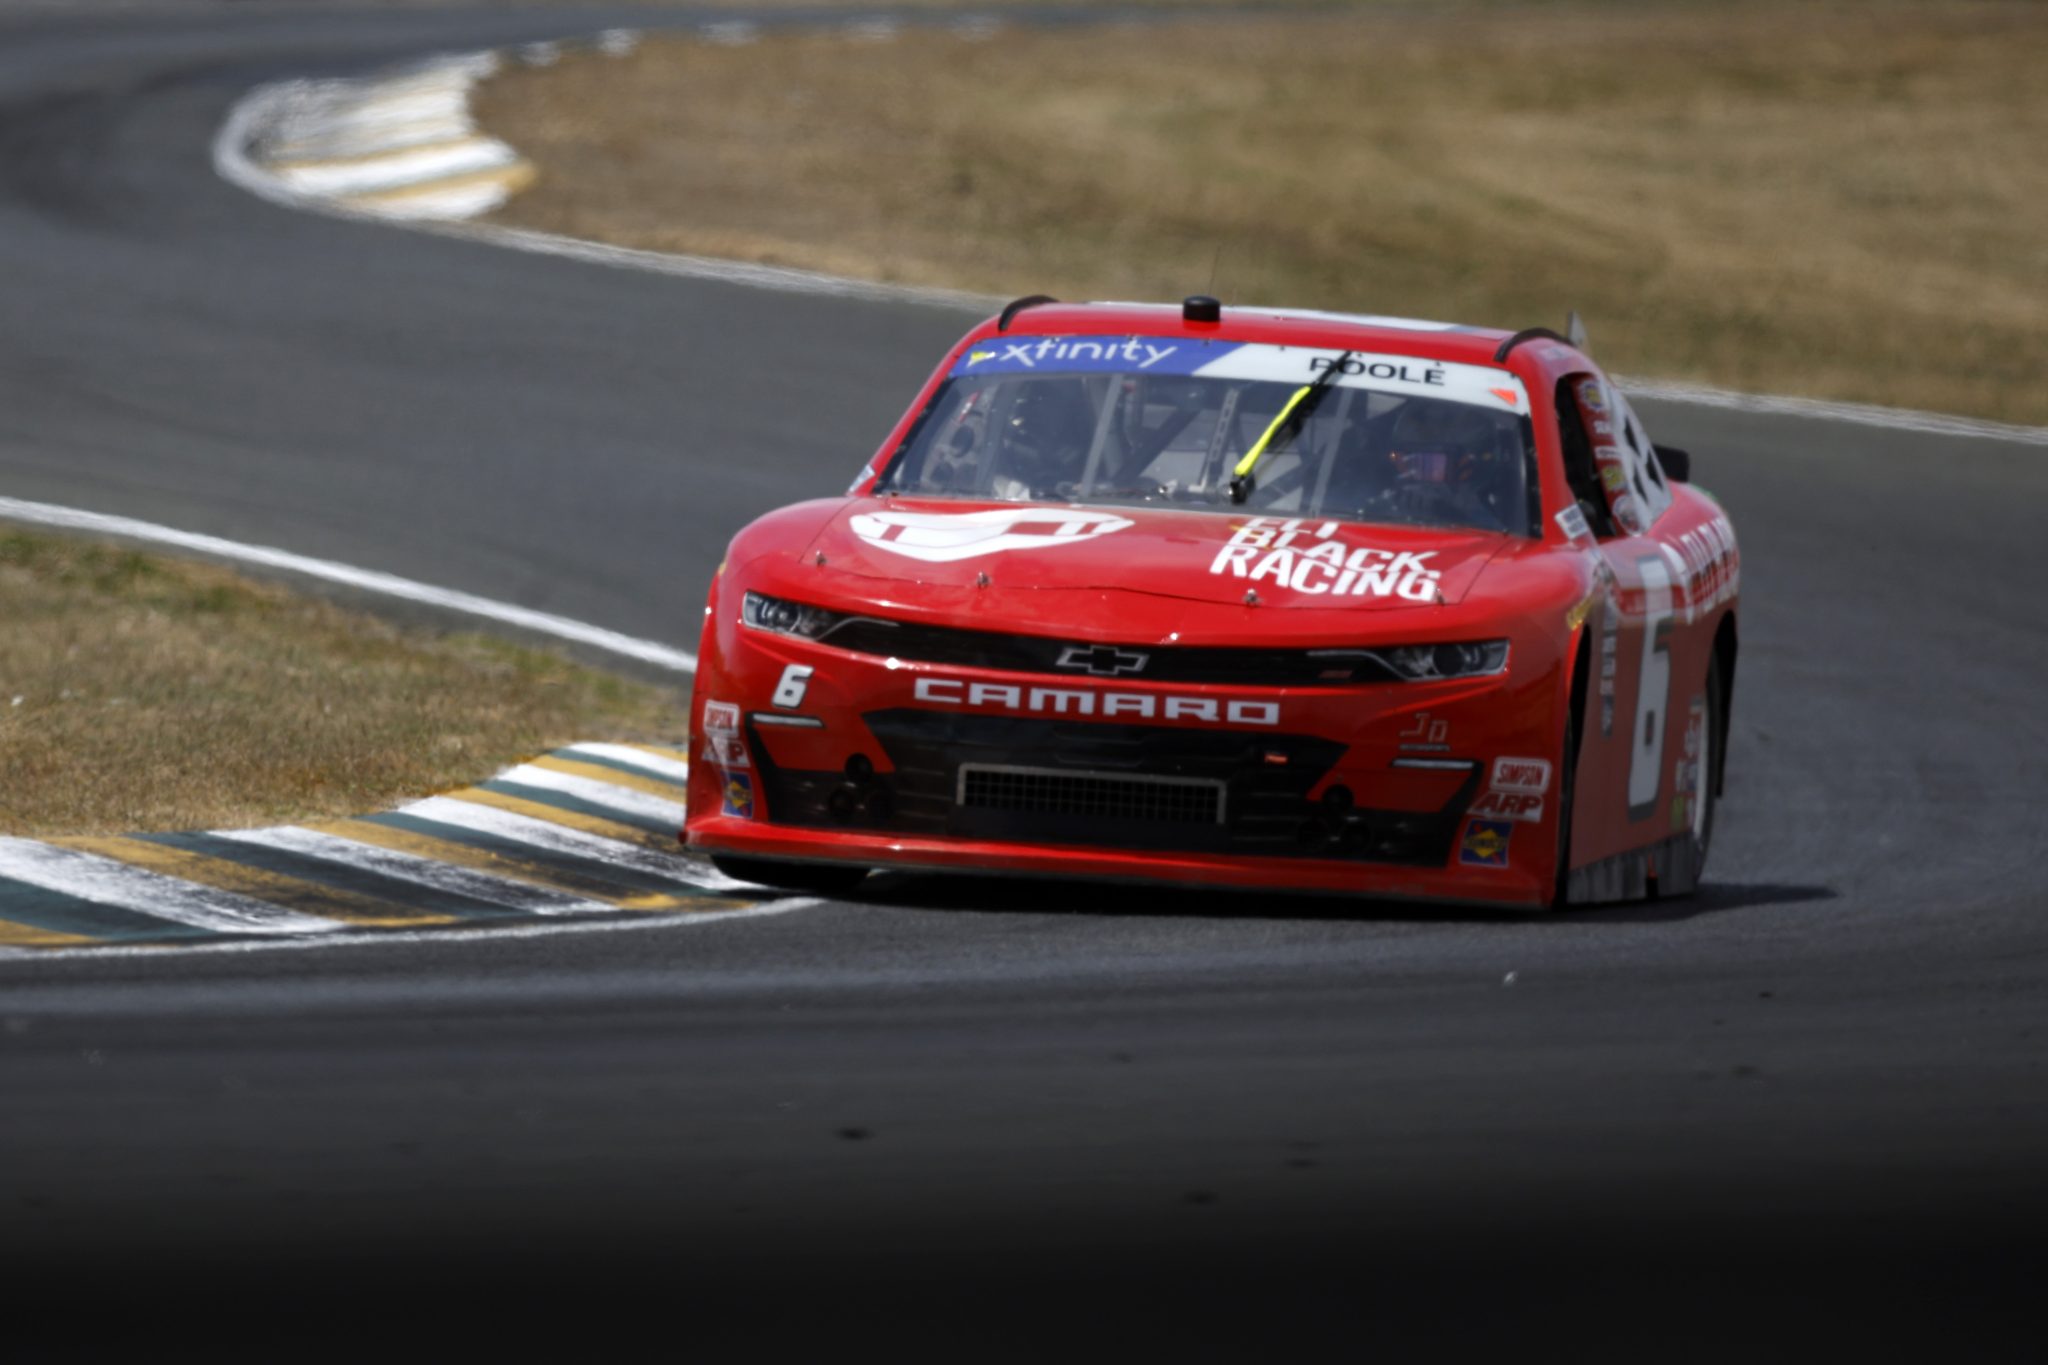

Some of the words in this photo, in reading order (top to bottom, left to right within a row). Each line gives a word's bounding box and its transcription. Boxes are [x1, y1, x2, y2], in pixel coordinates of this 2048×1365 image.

[999, 338, 1178, 368] xfinity
[1309, 357, 1446, 386] POOLE
[1227, 527, 1439, 573] BLACK
[1210, 545, 1441, 601] RACING
[772, 664, 814, 708] 6
[914, 677, 1280, 725] CAMARO
[1628, 556, 1676, 818] 6
[1497, 763, 1544, 786] SIMPSON
